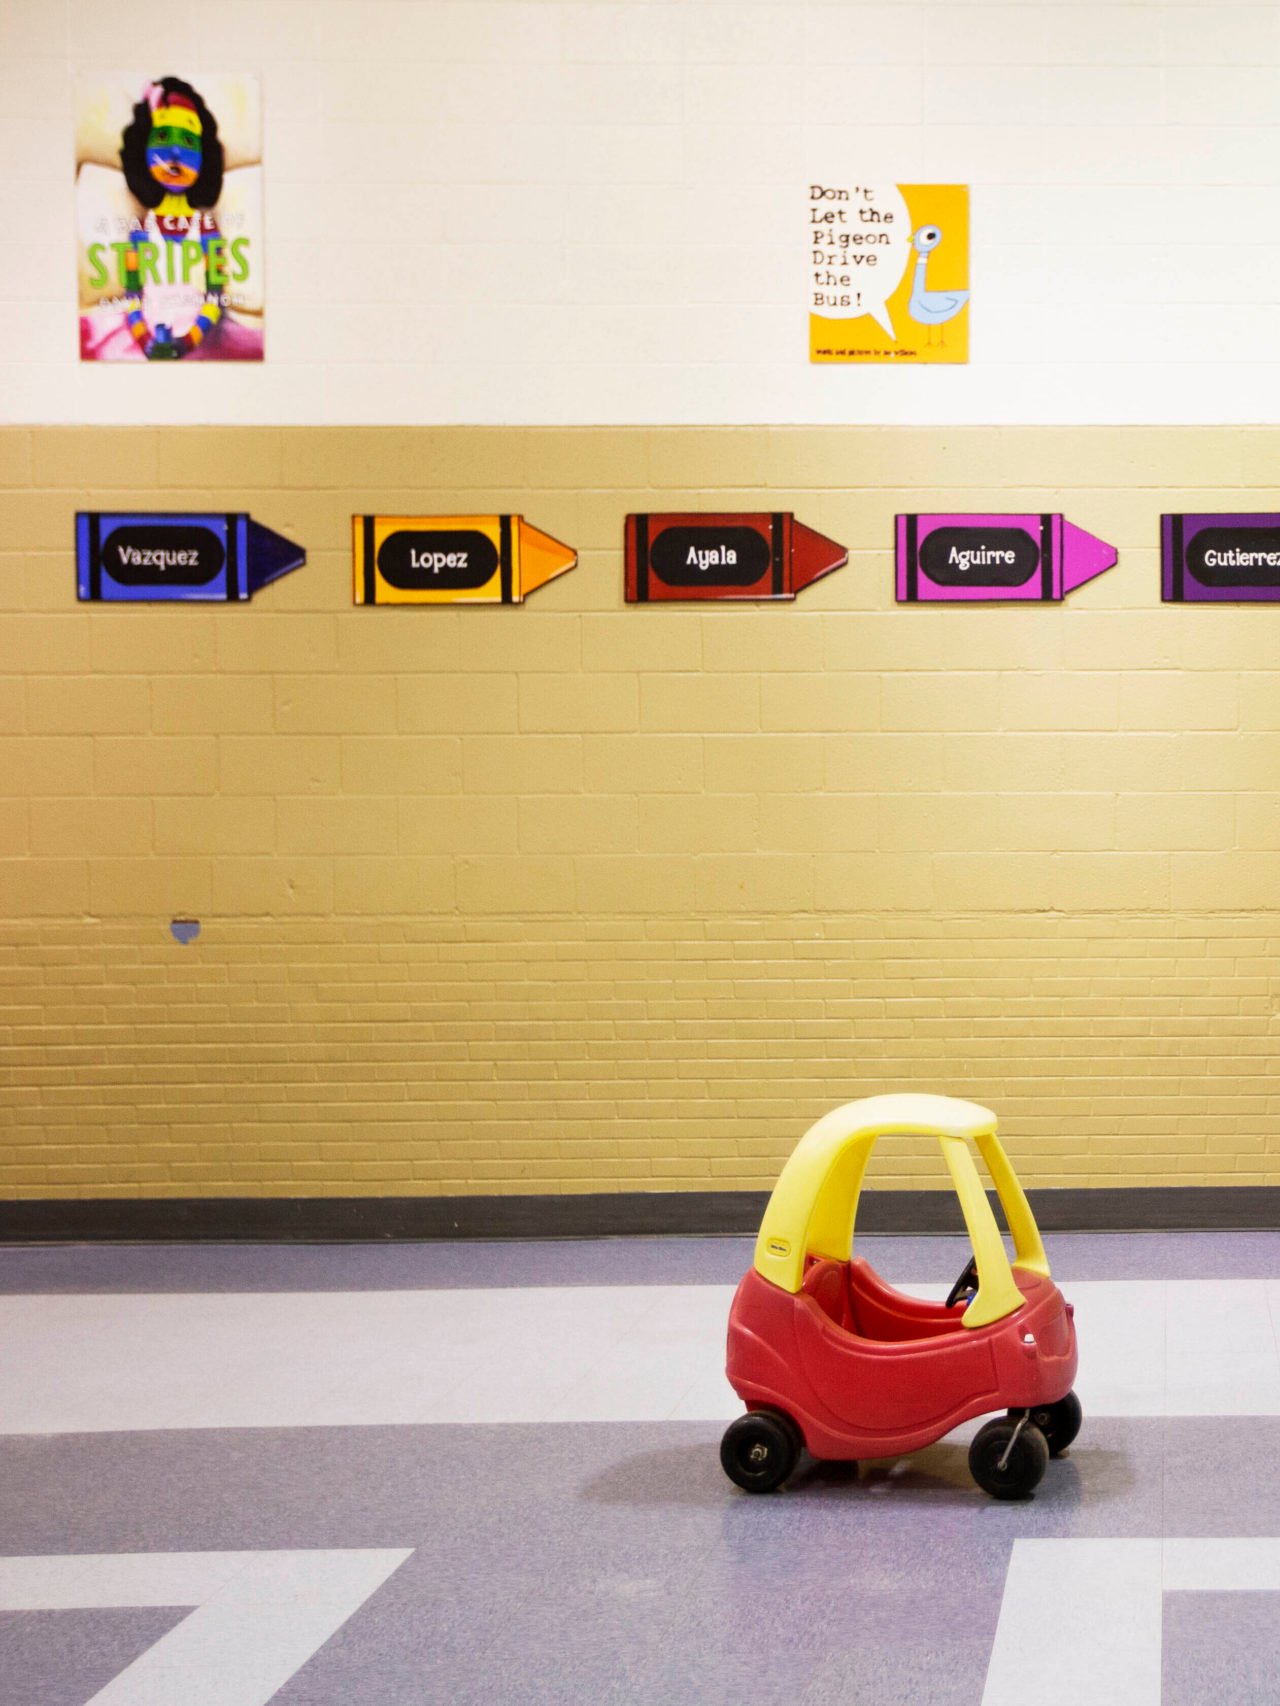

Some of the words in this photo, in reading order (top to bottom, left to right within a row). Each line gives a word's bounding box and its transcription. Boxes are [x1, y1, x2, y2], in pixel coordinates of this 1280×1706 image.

[809, 184, 873, 201] Don't
[809, 207, 847, 224] Let
[858, 207, 894, 224] the
[812, 228, 891, 249] Pigeon
[87, 237, 250, 290] STRIPES
[812, 248, 878, 266] Drive
[814, 270, 851, 286] the
[813, 292, 862, 307] Bus!
[117, 545, 199, 571] Vazquez
[410, 548, 469, 574] Lopez
[685, 544, 738, 570] Ayala
[947, 544, 1017, 571] Aguirre
